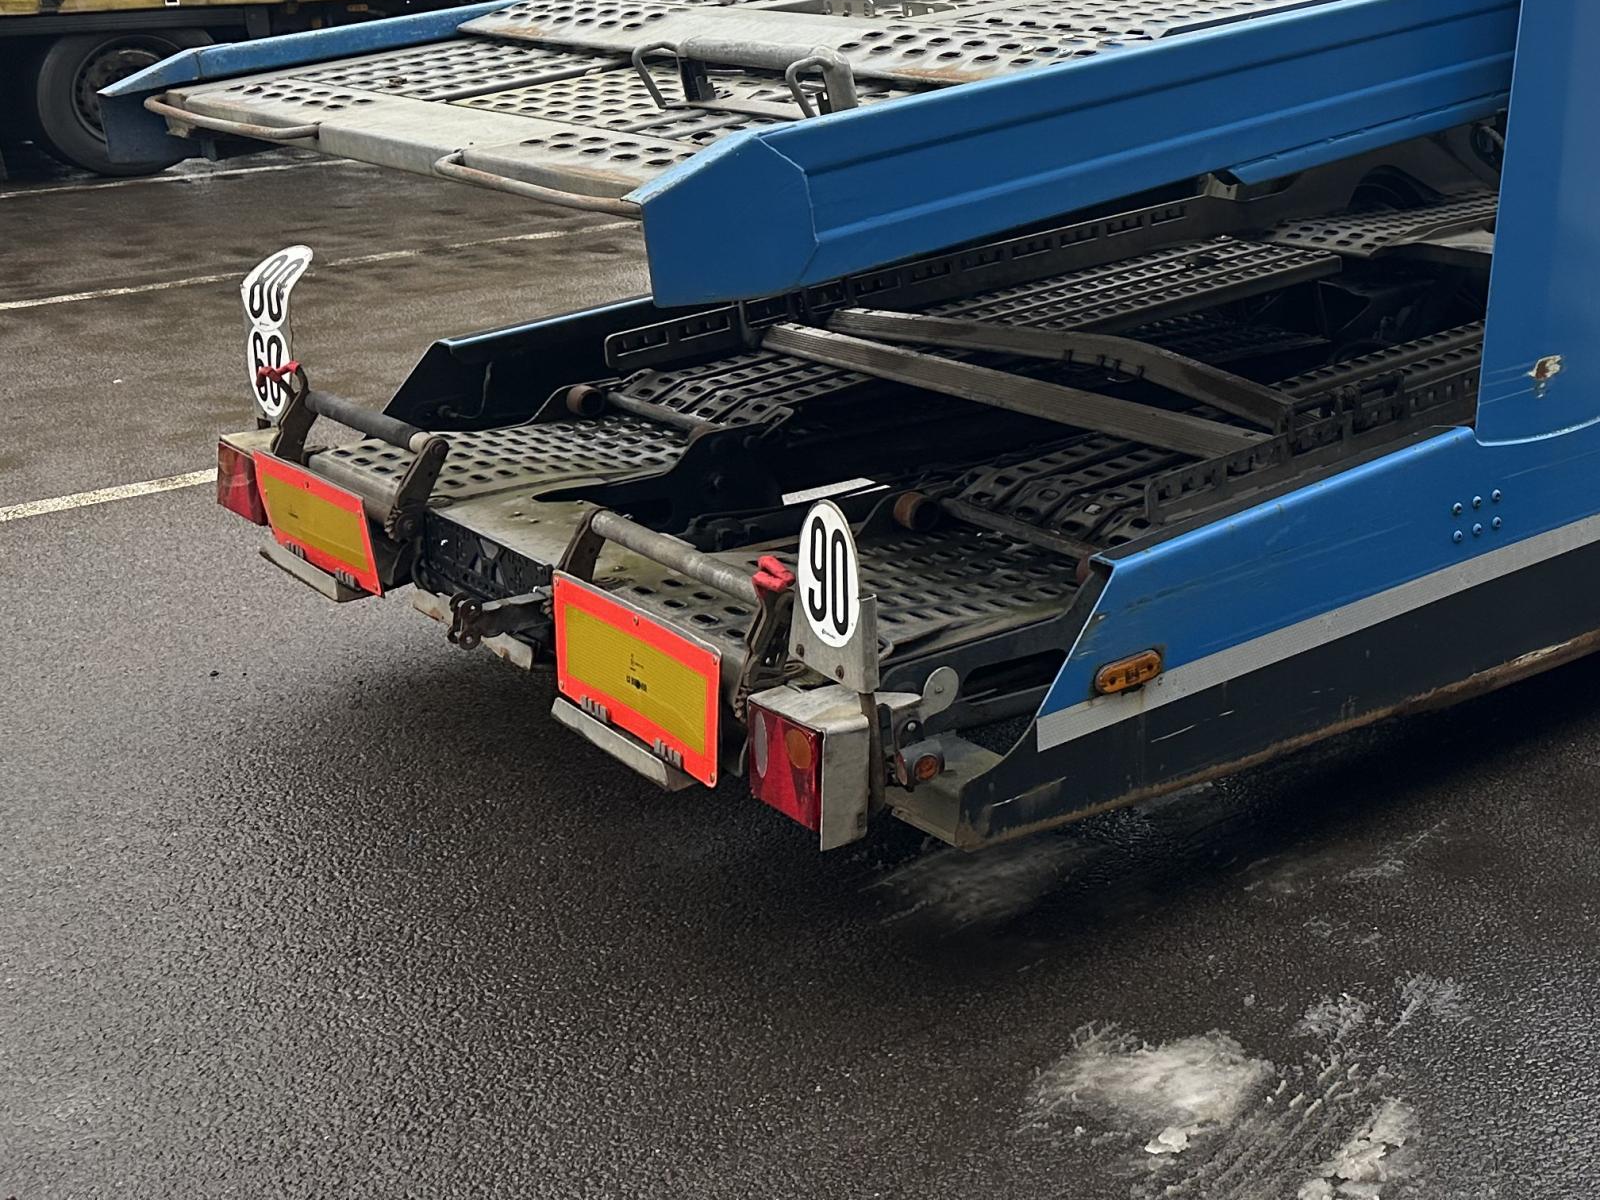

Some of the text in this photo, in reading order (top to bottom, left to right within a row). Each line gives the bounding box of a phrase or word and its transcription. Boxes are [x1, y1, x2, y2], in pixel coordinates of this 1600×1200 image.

[249, 254, 304, 322] 80
[252, 331, 283, 407] 60
[808, 515, 849, 636] 90
